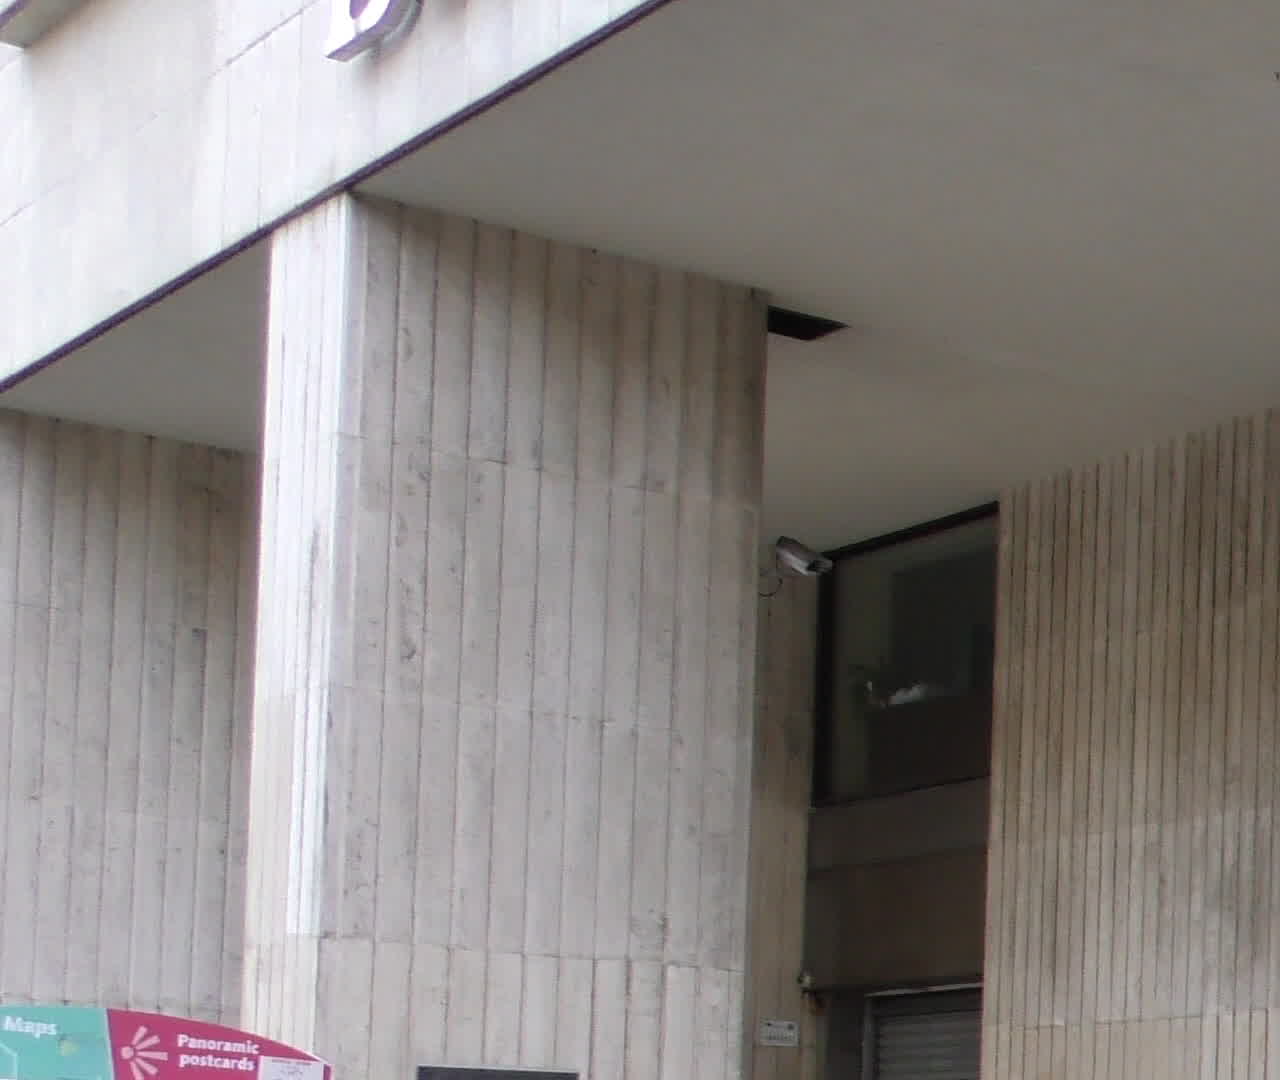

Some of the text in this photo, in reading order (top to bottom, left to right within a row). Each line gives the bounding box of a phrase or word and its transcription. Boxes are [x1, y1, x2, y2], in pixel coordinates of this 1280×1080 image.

[3, 1014, 57, 1039] Maps
[176, 1033, 260, 1056] Panoramic
[178, 1053, 256, 1073] postcards
